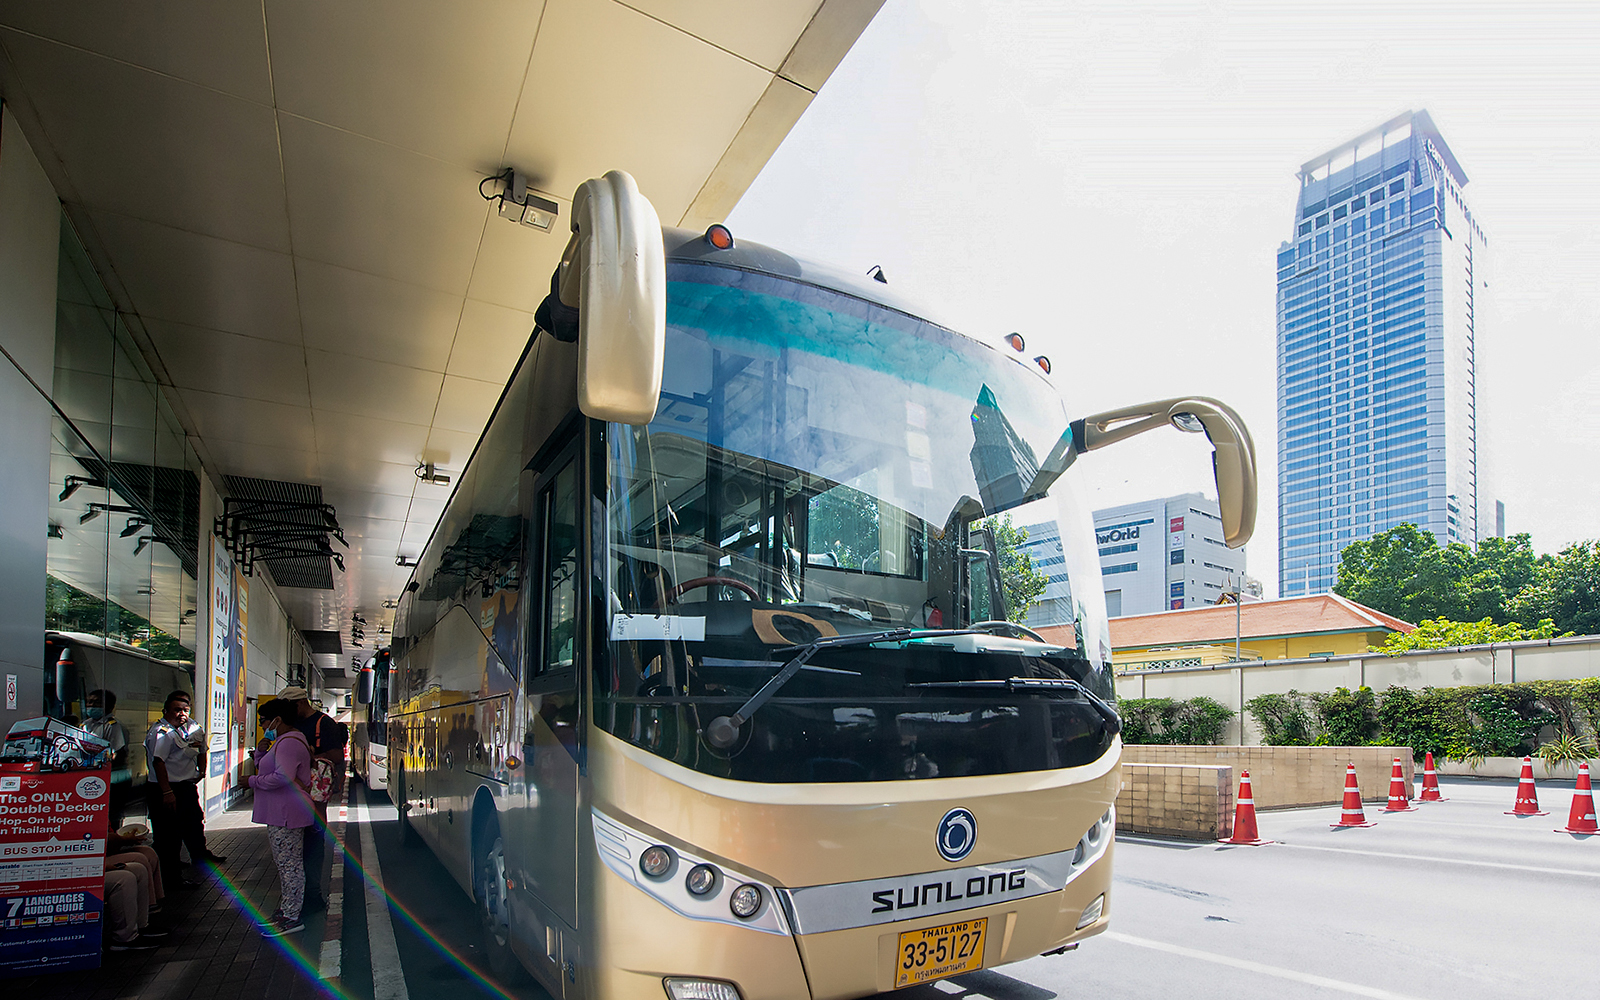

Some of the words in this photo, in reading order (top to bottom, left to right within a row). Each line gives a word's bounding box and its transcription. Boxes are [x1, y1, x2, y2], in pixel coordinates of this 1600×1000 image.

[0, 794, 27, 804] The
[31, 792, 73, 803] ONLY
[0, 804, 51, 814] Double
[56, 802, 106, 812] Decker
[0, 816, 44, 826] Hop-On
[48, 814, 94, 825] Hop-Off
[12, 825, 61, 835] Thailand
[4, 847, 28, 856] BUS
[31, 845, 62, 854] STOP
[64, 843, 95, 852] HERE
[871, 870, 1026, 913] SUNLONG
[25, 893, 85, 907] LANGUAGES
[7, 898, 24, 918] 7
[23, 904, 54, 915] AUDIO
[56, 902, 84, 913] GUIDE
[922, 923, 968, 939] THAILAND
[974, 921, 982, 929] 01
[903, 931, 982, 970] 33-5127
